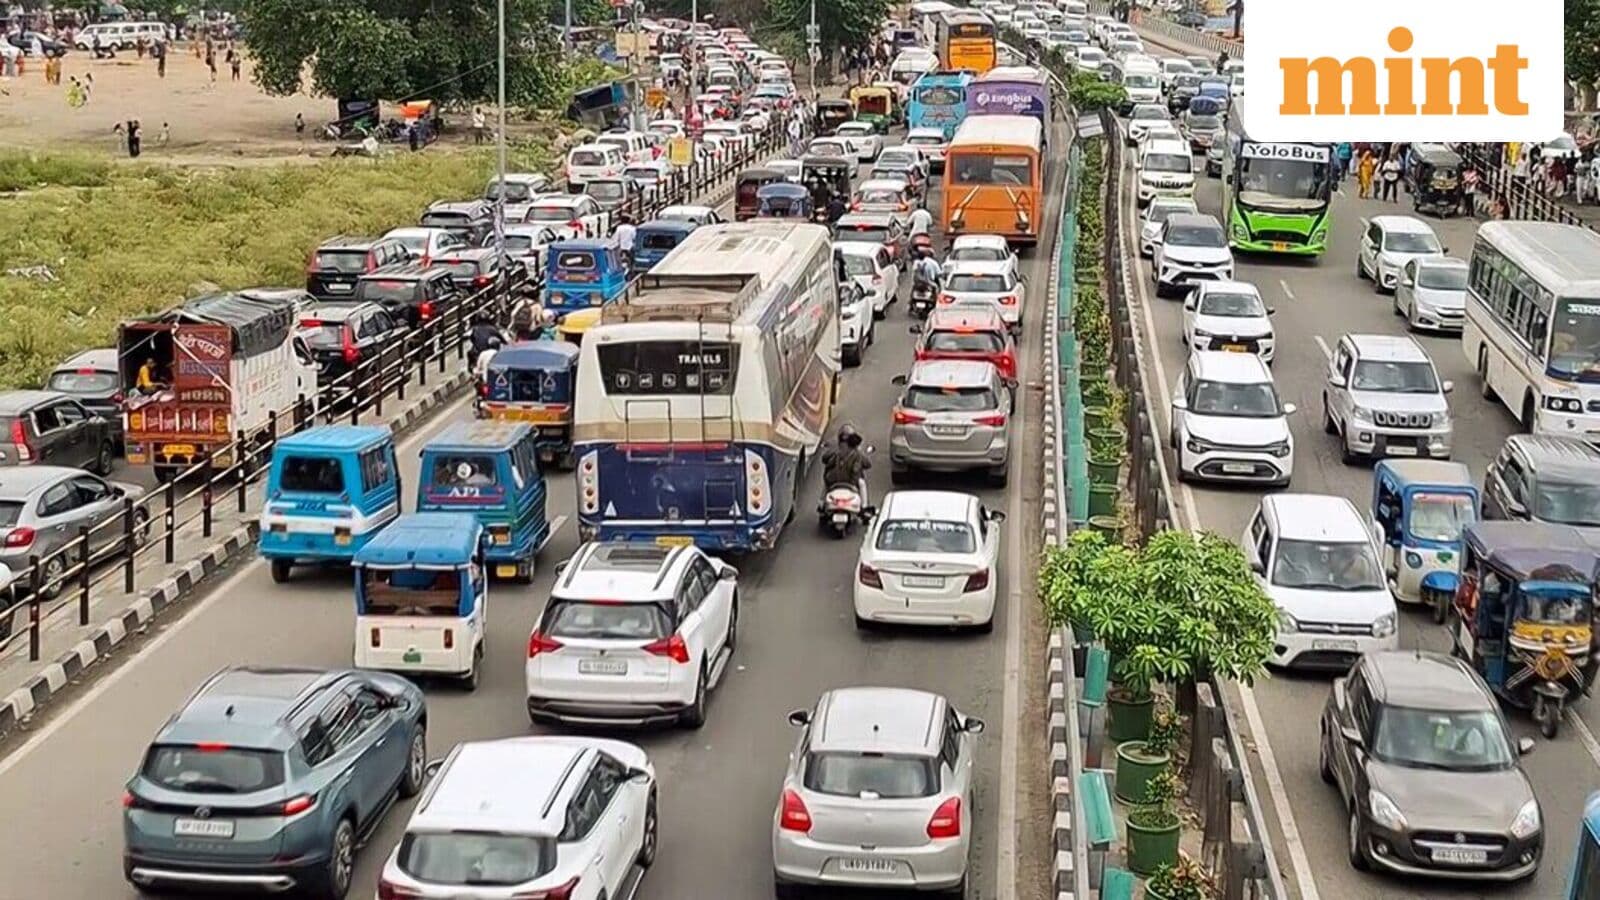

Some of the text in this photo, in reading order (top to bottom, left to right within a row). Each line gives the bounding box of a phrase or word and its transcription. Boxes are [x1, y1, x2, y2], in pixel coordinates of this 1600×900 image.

[1249, 145, 1324, 160] YoloBus
[679, 354, 721, 364] TRAVELS
[181, 389, 225, 401] HORN
